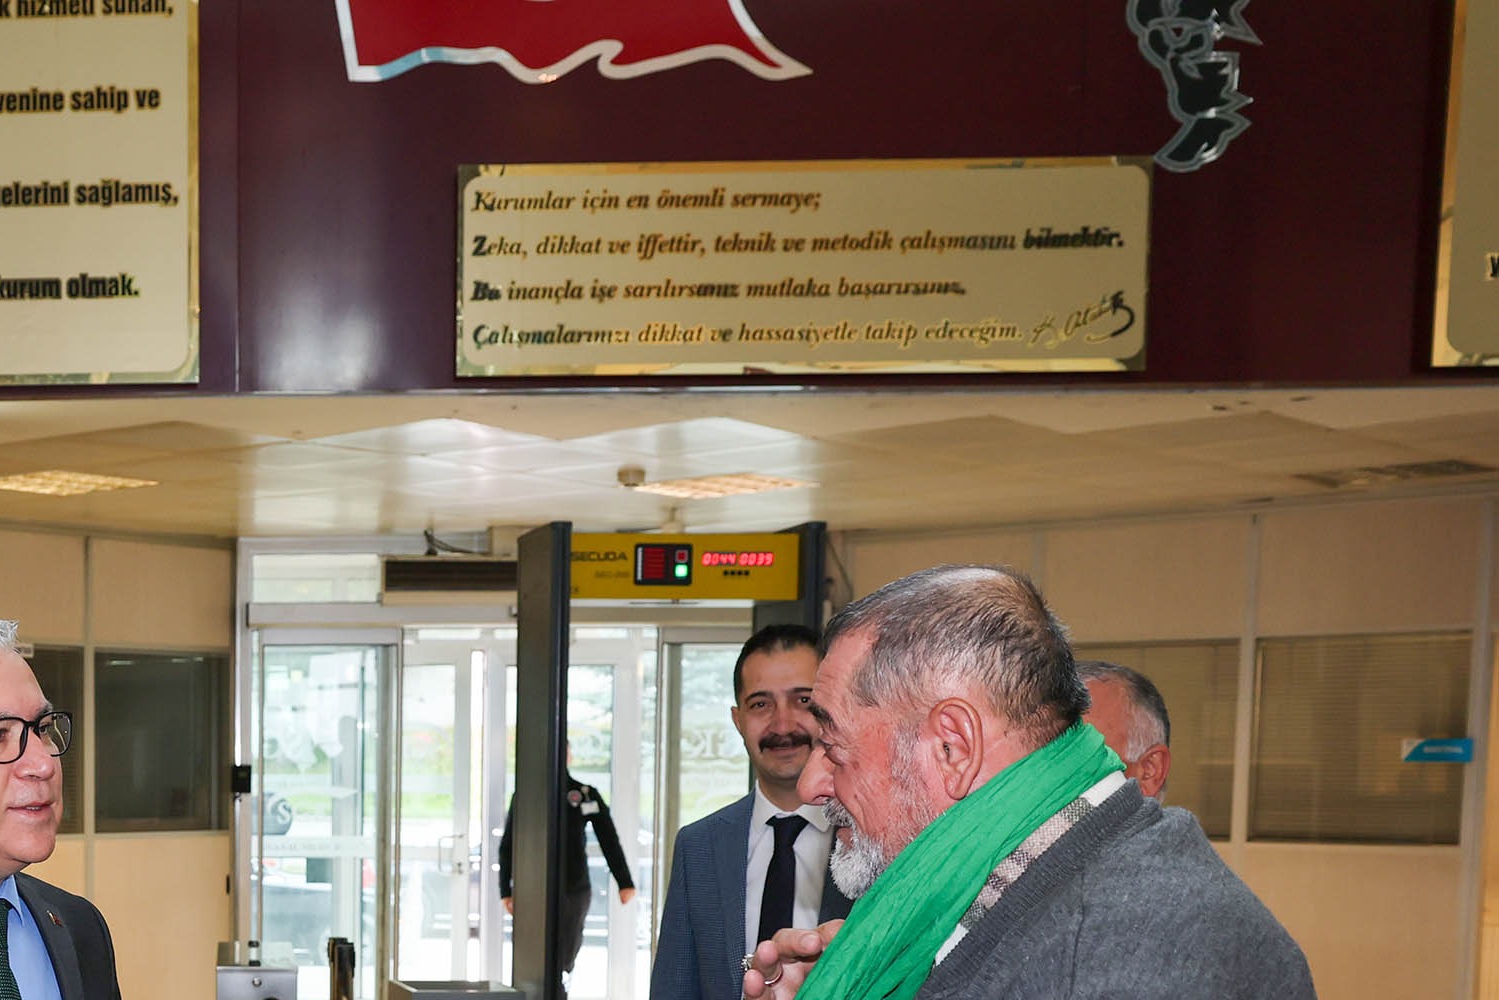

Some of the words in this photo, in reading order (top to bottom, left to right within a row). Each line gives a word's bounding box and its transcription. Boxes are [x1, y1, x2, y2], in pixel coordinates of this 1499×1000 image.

[71, 86, 129, 113] sahip
[136, 90, 160, 109] ve
[76, 179, 179, 208] sağlamış,
[471, 190, 576, 213] Kurumlar
[582, 189, 619, 214] için
[626, 194, 650, 209] en
[656, 187, 726, 210] önemli
[731, 192, 822, 214] sermaye;
[472, 235, 529, 260] Zeka,
[536, 235, 602, 255] dikkat
[608, 240, 630, 255] ve
[636, 233, 706, 260] iffettir,
[713, 231, 777, 253] teknik
[783, 237, 805, 252] ve
[811, 230, 893, 251] metodik
[900, 229, 1016, 255] çalışmasını
[67, 273, 140, 299] olmak.
[471, 281, 502, 301] Bu
[507, 280, 583, 304] inançla
[590, 279, 618, 303] işe
[746, 277, 831, 298] mutlaka
[638, 323, 704, 344] dikkat
[709, 327, 732, 343] ve
[737, 321, 857, 349] hassasiyetle
[865, 320, 917, 347] takip
[925, 318, 1022, 347] edeceğim.
